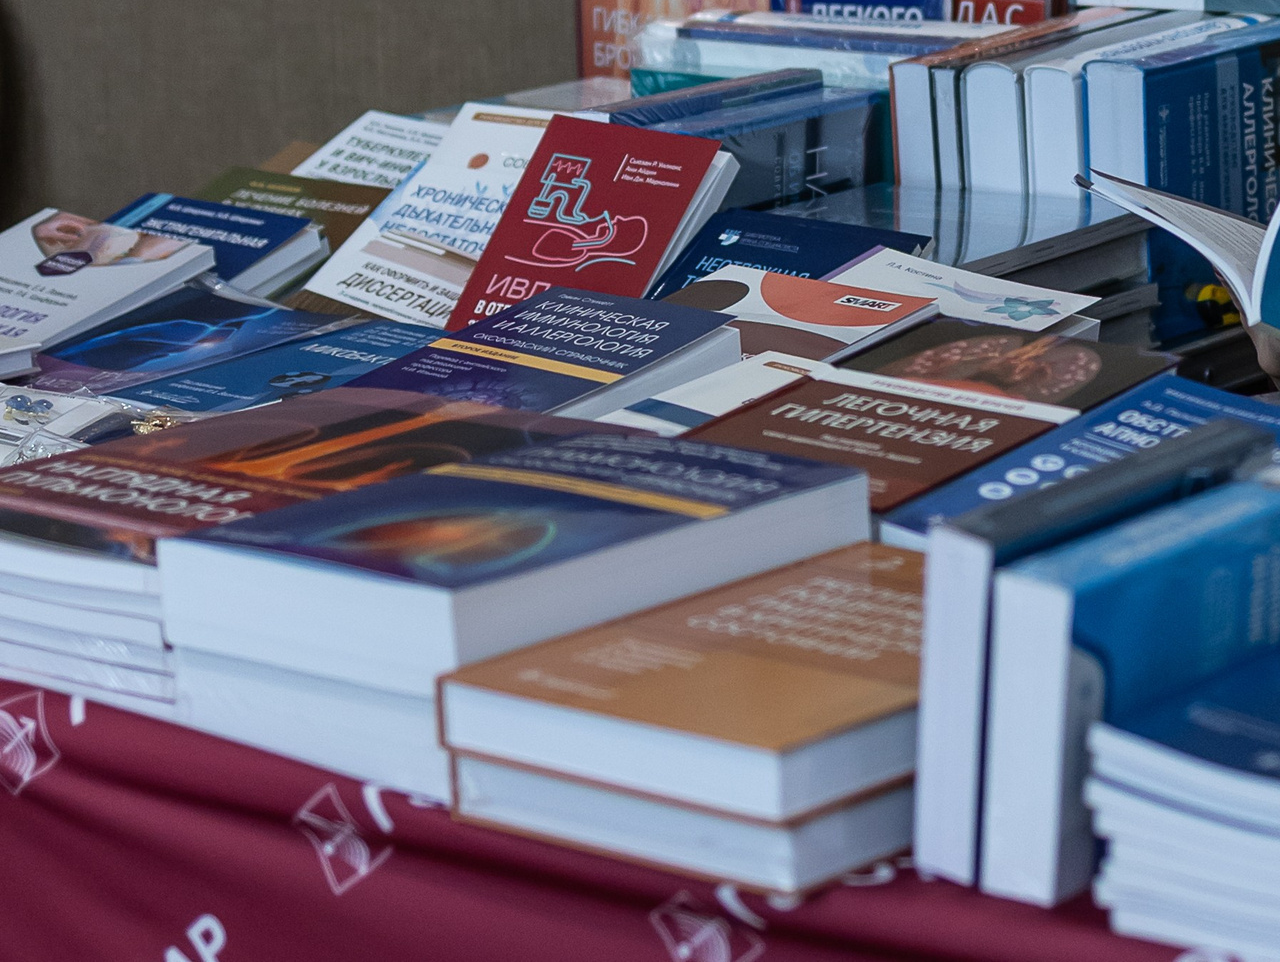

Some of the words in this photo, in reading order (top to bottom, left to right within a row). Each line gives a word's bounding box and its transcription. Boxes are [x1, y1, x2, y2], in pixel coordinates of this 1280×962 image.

[316, 159, 328, 170] У
[329, 148, 344, 158] И
[362, 261, 380, 272] КАК
[904, 267, 943, 281] Костина
[485, 274, 552, 300] ИВЛ
[474, 299, 486, 314] В
[535, 300, 670, 330] КЛИНИЧЕСКАЯ
[840, 296, 895, 310] SMART
[493, 320, 509, 331] И
[511, 323, 653, 359] АЛЛЕРГОЛОГИЯ
[514, 310, 659, 345] ИММУНОЛОГИЯ
[451, 342, 482, 353] ВТОРОЕ
[481, 348, 519, 360] ИЗДАНИЕ
[473, 333, 554, 354] ОКСФОРДСКИЙ
[555, 349, 629, 369] СПРАВОЧНИК
[822, 392, 1000, 434] ЛЕГОЧНАЯ
[770, 403, 994, 453] ГИПЕРТЕНЗИЯ
[37, 461, 252, 505] НАГЛЯДНАЯ
